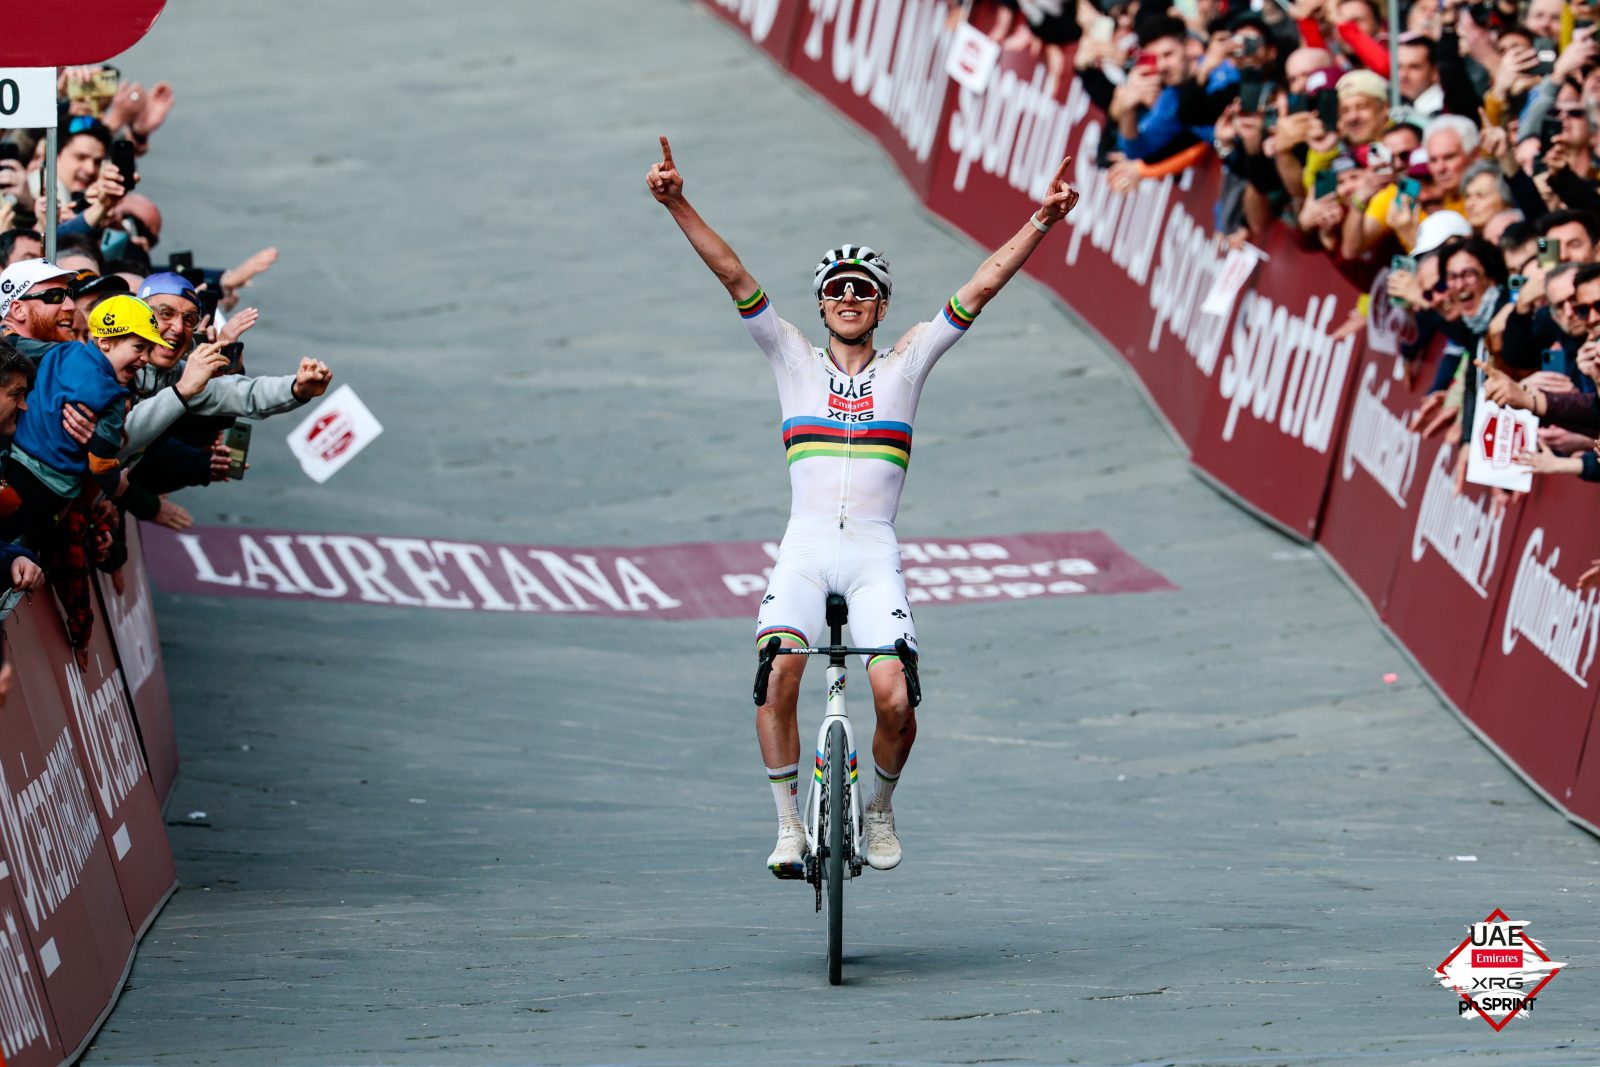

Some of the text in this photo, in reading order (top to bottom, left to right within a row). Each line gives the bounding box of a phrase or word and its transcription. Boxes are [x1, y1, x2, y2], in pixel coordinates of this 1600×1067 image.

[1220, 288, 1356, 454] sportful
[829, 377, 873, 399] UAE
[832, 397, 870, 410] Emirates
[827, 408, 874, 422] XRG
[177, 533, 682, 611] LAURETANA
